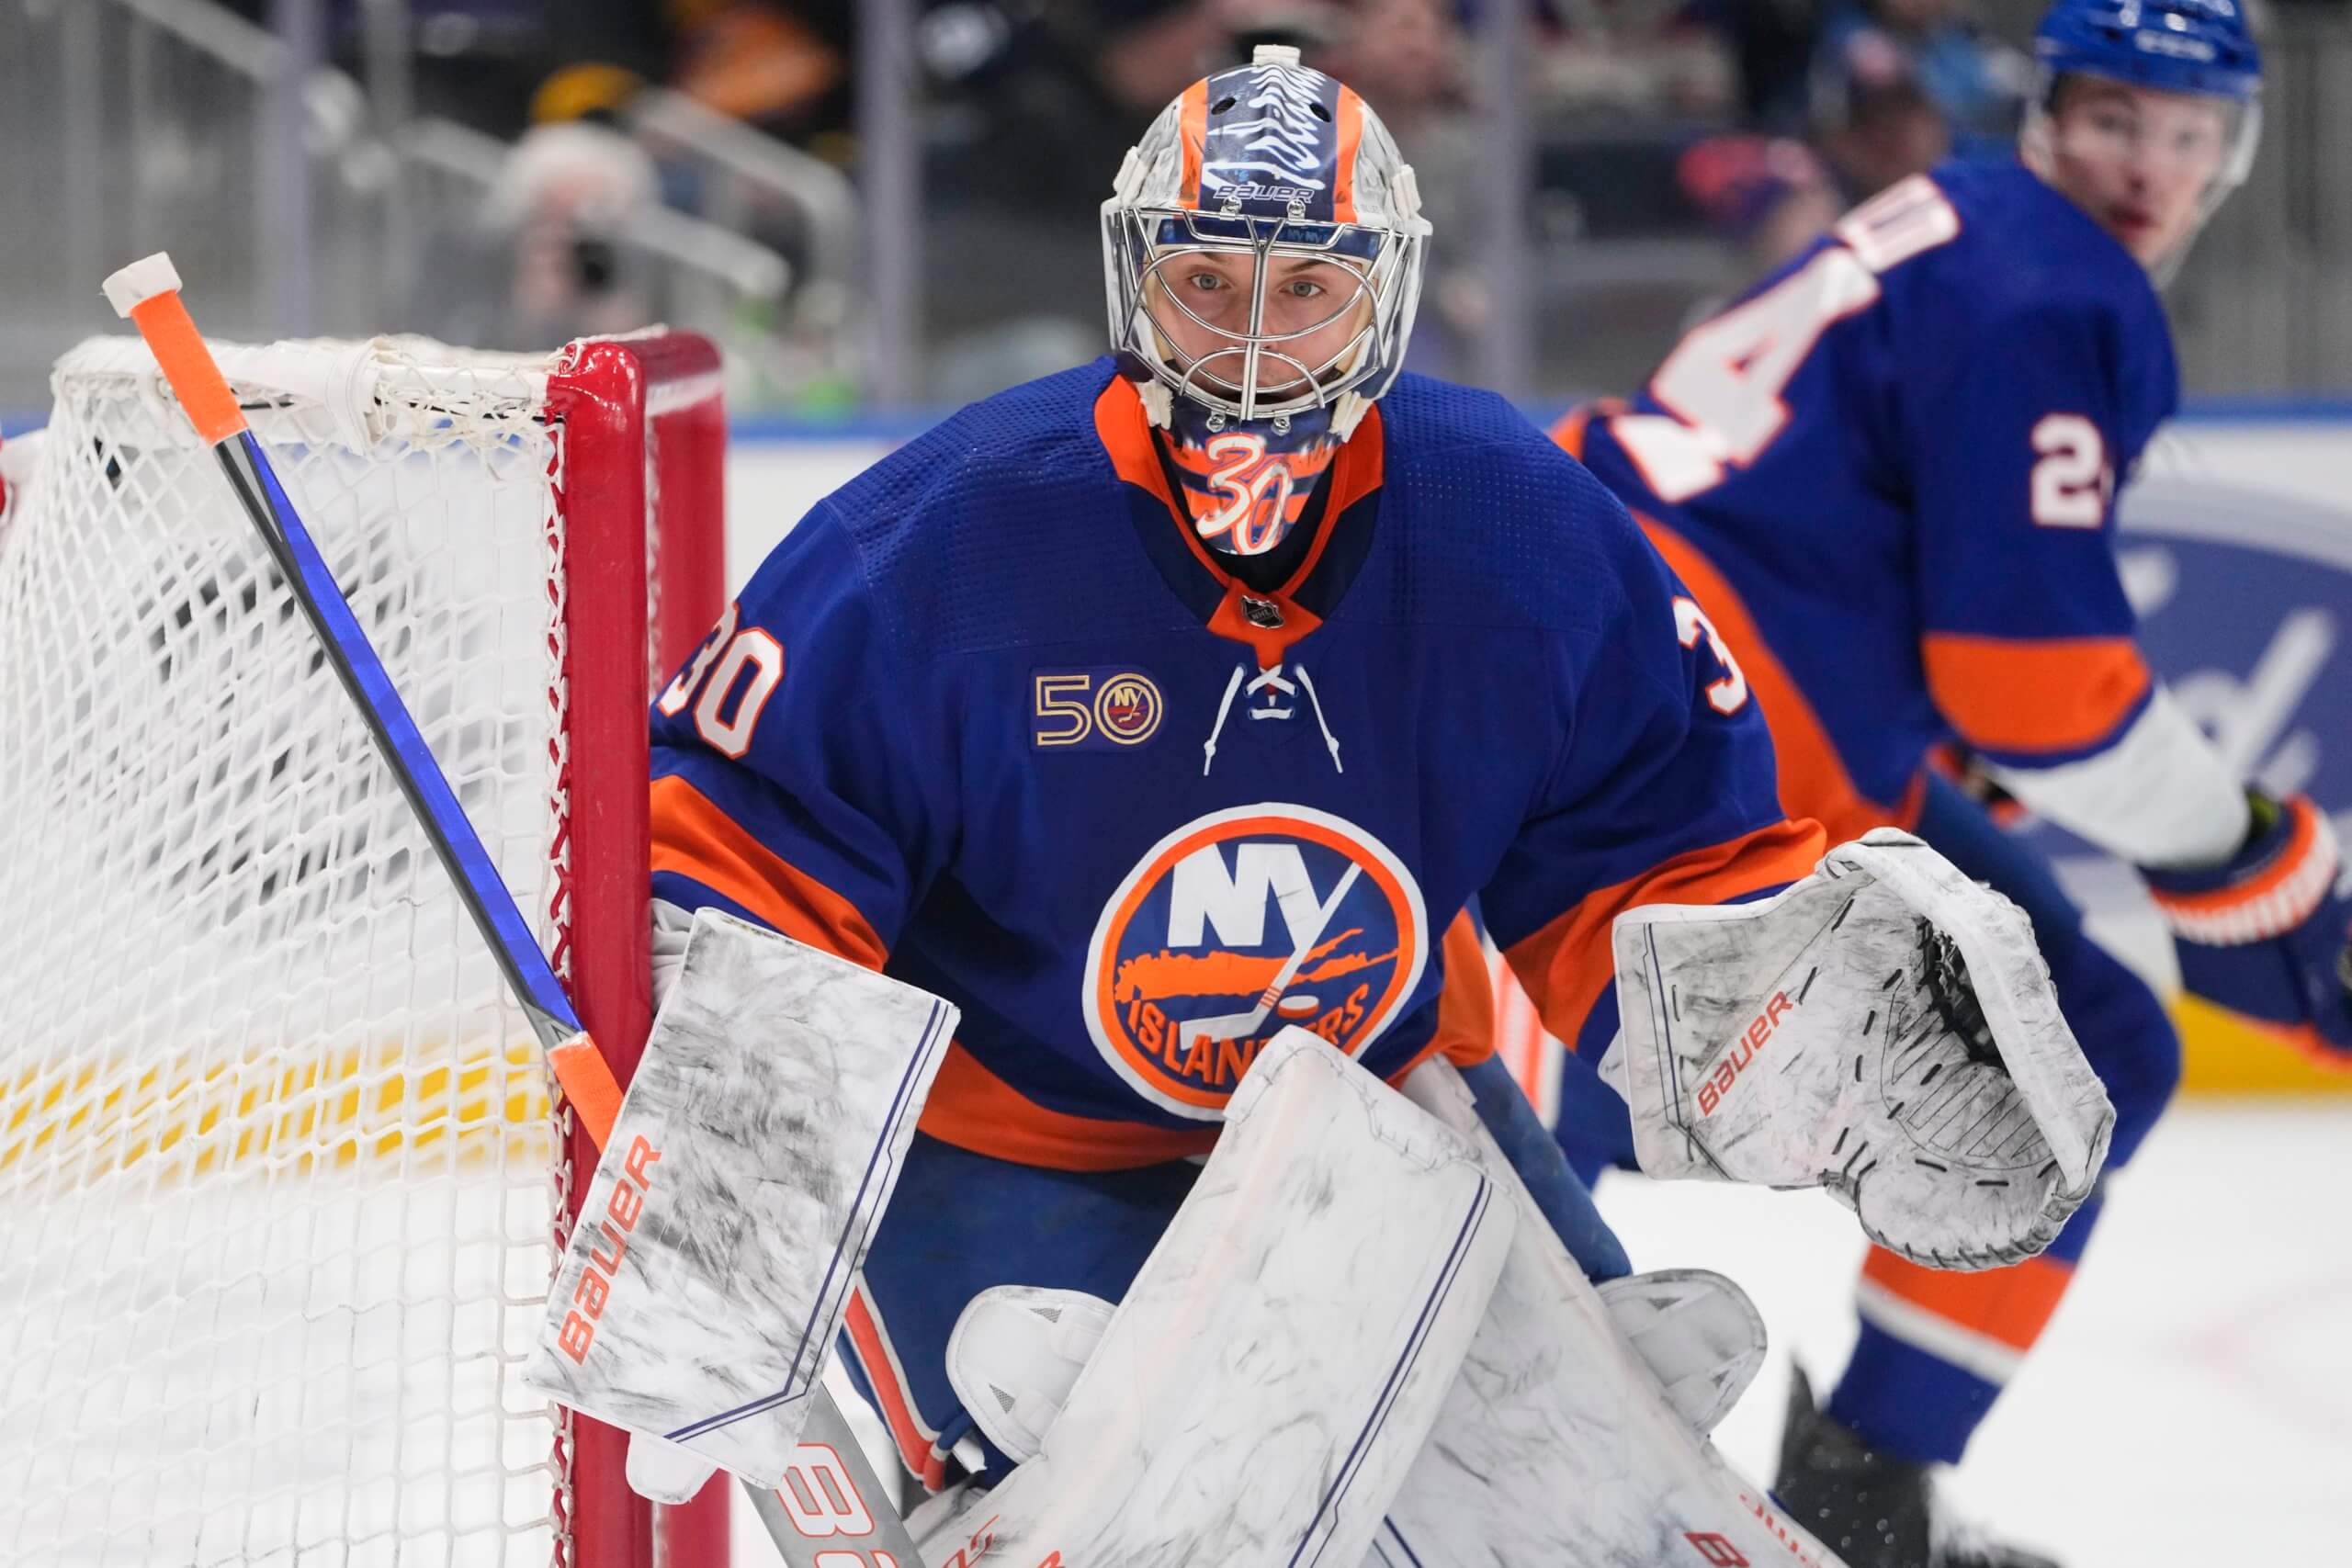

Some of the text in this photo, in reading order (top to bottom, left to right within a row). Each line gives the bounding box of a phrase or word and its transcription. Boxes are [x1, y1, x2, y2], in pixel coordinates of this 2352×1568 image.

[1196, 432, 1293, 555] 30
[656, 600, 786, 761] 30
[1035, 672, 1162, 746] 50
[1167, 842, 1363, 950] NY
[1126, 984, 1370, 1087] ISLANRS
[1697, 990, 1794, 1117] BAUER
[557, 1133, 662, 1367] BAUER
